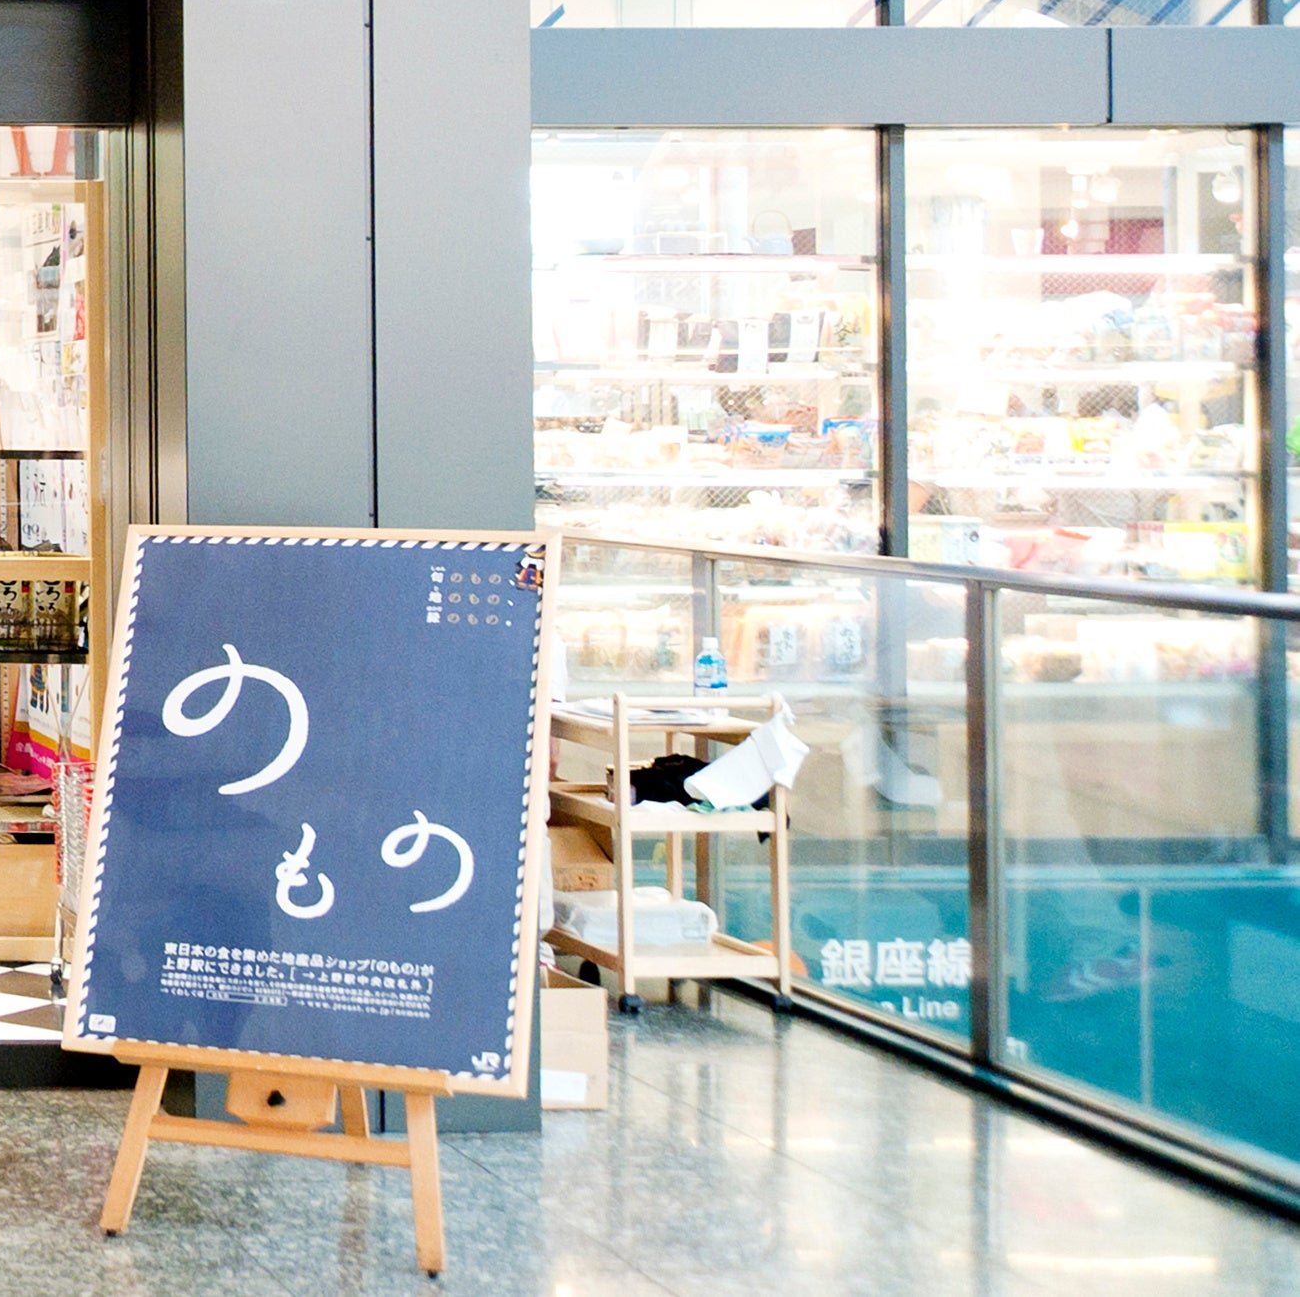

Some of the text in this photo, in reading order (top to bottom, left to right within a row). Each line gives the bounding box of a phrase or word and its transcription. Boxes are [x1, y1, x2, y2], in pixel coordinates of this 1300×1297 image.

[820, 937, 972, 988] 銀座線
[902, 996, 960, 1020] Line
[470, 1051, 502, 1073] JR
